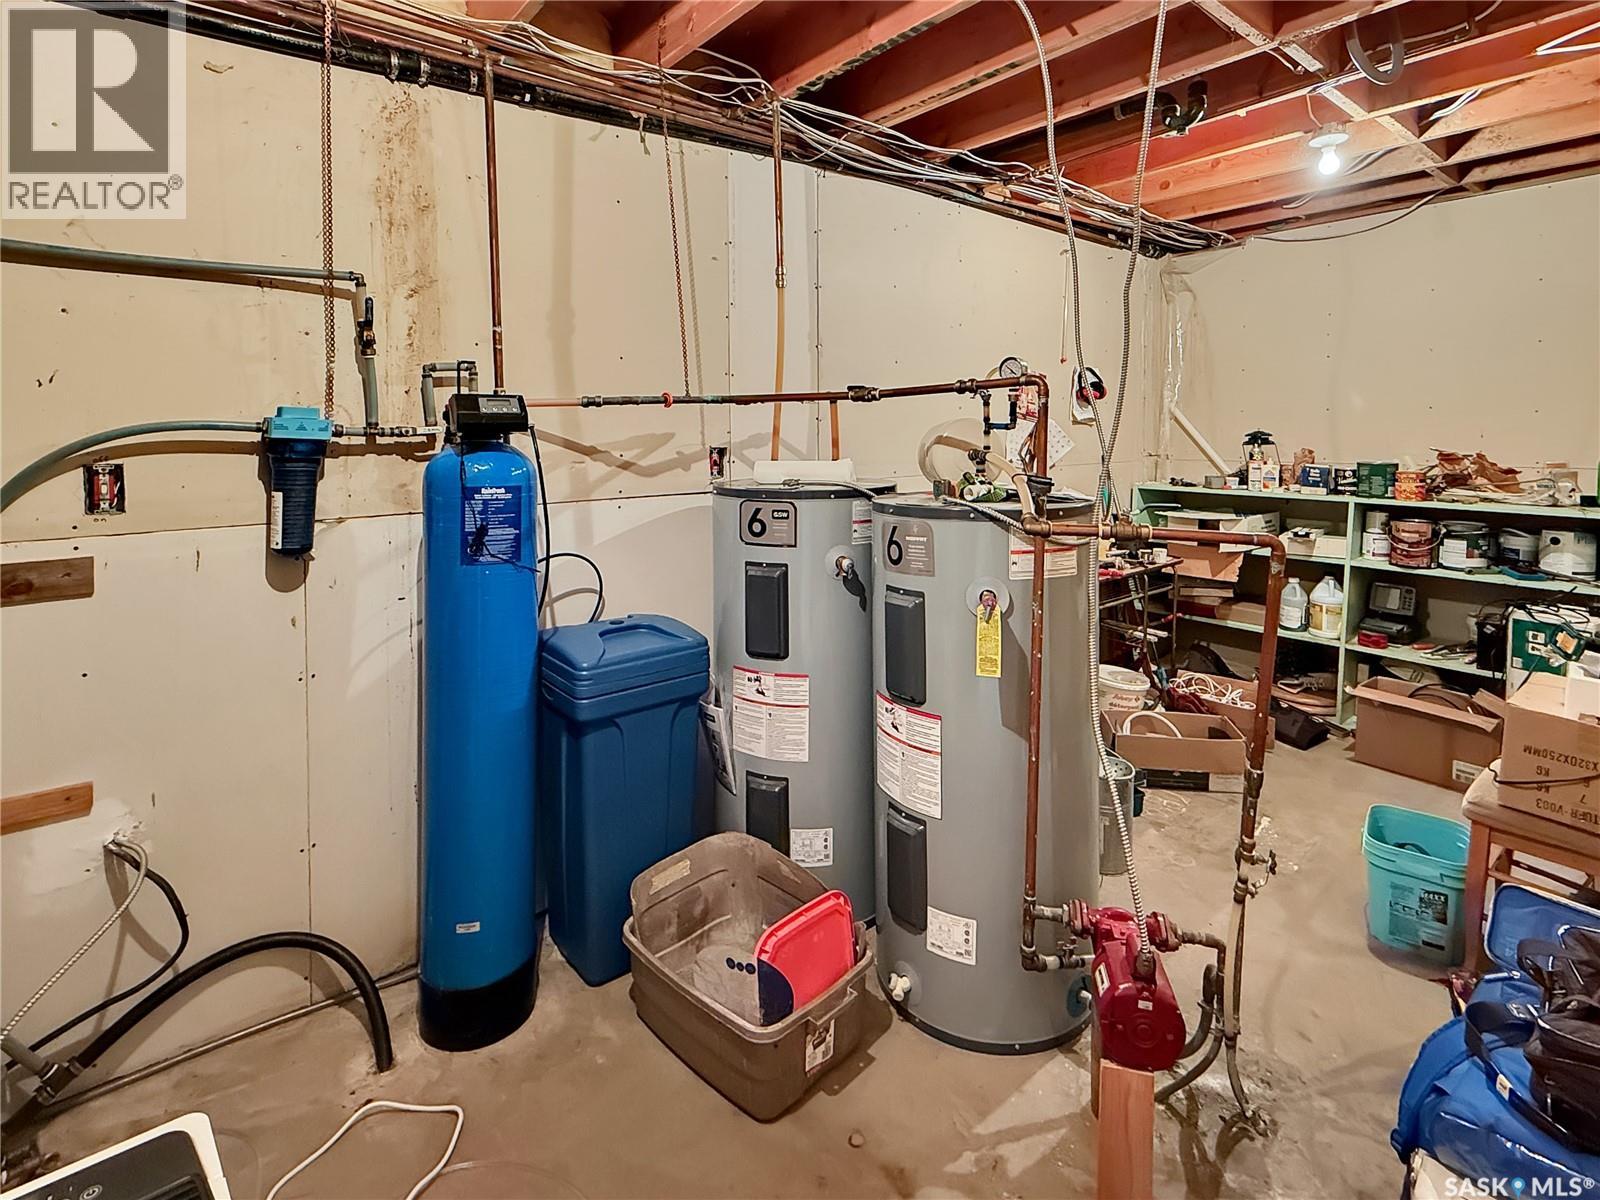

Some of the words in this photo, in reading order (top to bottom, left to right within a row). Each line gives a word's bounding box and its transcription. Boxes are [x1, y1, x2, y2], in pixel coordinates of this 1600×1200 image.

[747, 507, 767, 538] 6
[772, 511, 789, 519] GSW
[887, 525, 903, 566] 6
[1535, 765, 1550, 777] KG
